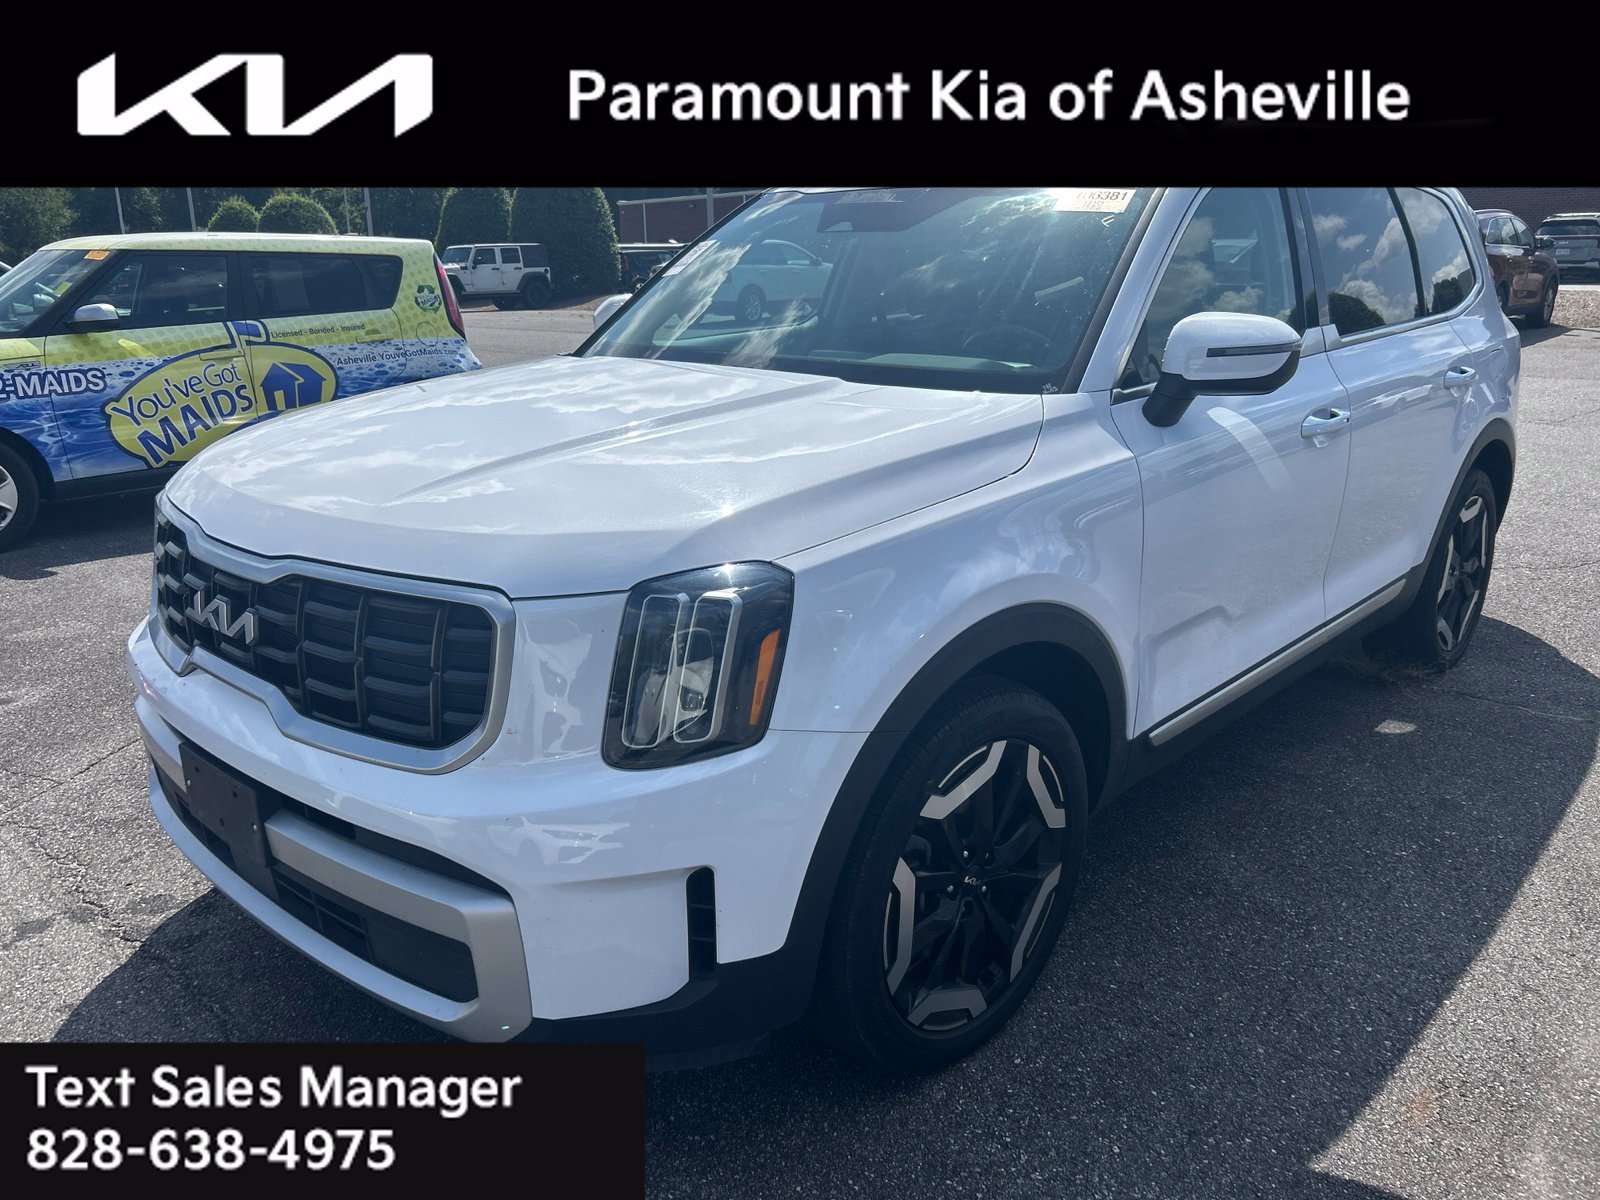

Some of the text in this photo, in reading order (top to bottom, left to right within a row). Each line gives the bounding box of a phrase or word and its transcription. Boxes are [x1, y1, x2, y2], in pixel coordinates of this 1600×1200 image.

[271, 329, 302, 338] Licensed
[309, 326, 335, 335] Bonded
[341, 323, 365, 333] Insured
[111, 363, 242, 426] You've Got
[137, 384, 253, 465] MAIDS
